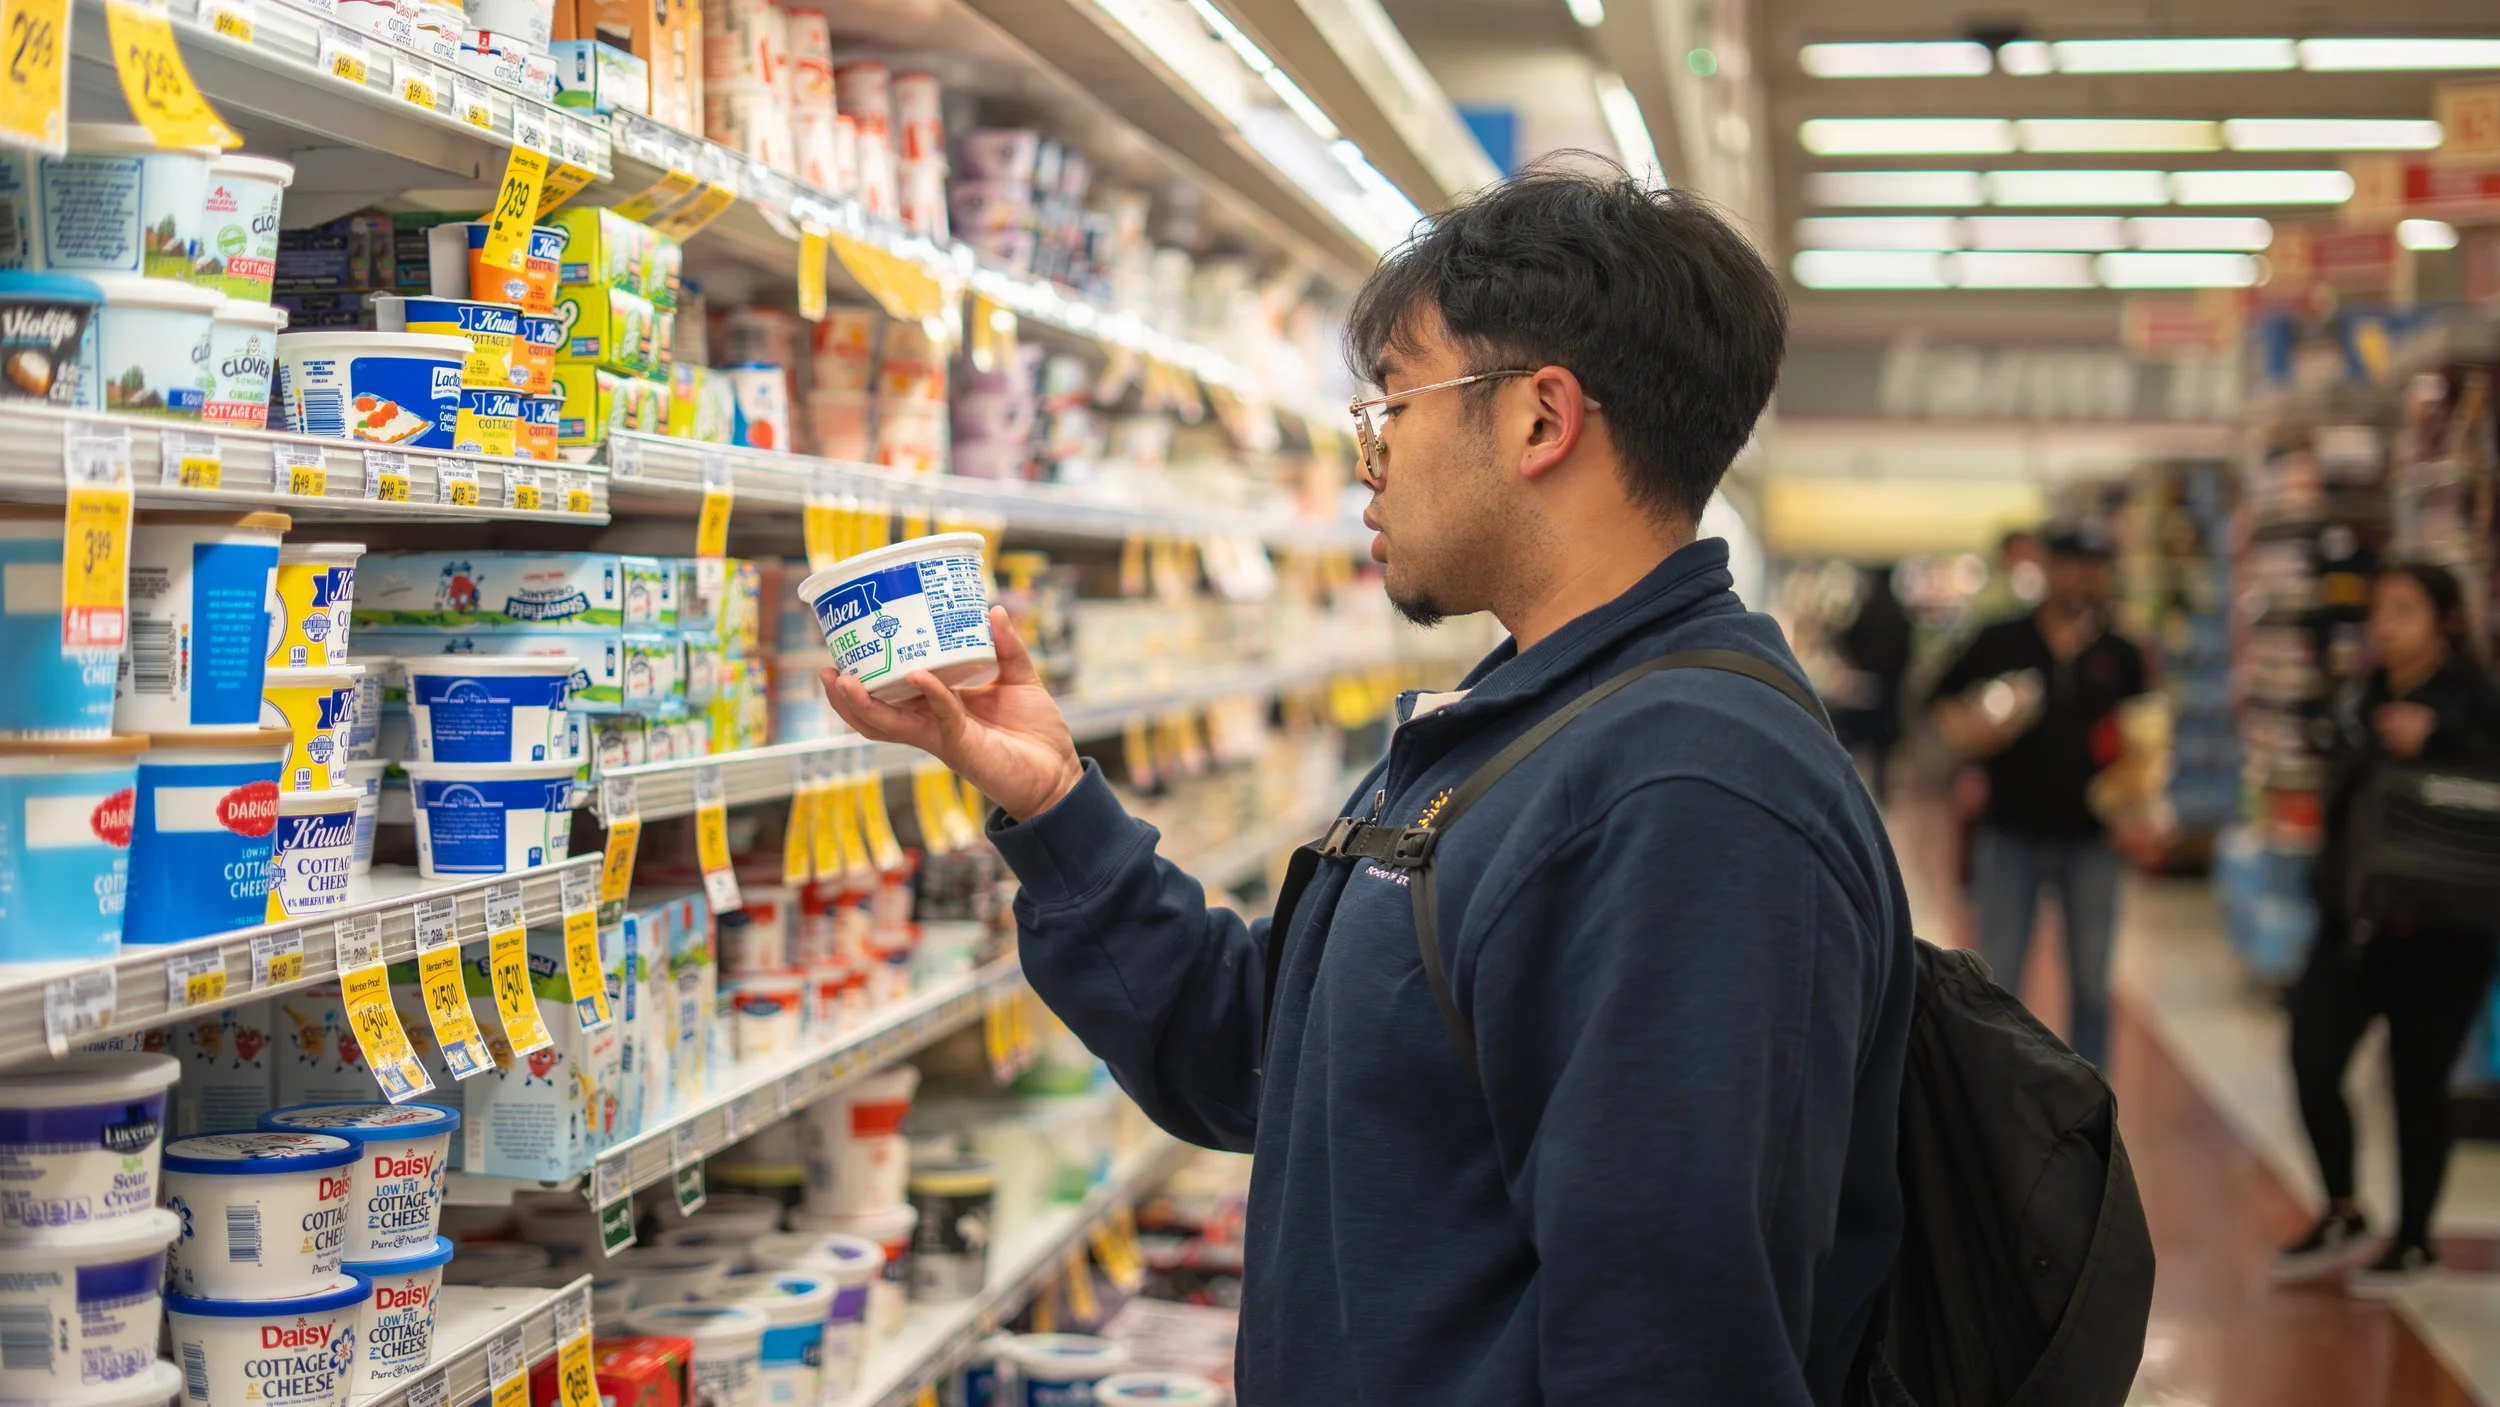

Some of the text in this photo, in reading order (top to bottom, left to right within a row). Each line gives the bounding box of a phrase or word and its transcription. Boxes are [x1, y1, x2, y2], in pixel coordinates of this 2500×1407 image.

[388, 18, 411, 36] COTTAGE
[440, 24, 457, 45] Daisy
[434, 42, 455, 59] COTTAGE
[501, 47, 520, 68] Daisy
[495, 66, 518, 81] COTTAGE
[2, 308, 78, 351] Violife
[222, 356, 270, 382] CLOVER
[294, 473, 310, 495] 649
[380, 480, 394, 500] 649
[919, 560, 944, 570] Nutrition
[922, 568, 936, 576] Facts
[509, 595, 587, 621] Stonyfield
[930, 602, 944, 610] Calories
[303, 620, 331, 628] CALIFORNIA
[834, 629, 860, 654] FREE
[896, 646, 906, 655] NET
[906, 644, 915, 652] WT
[293, 648, 306, 658] 110
[846, 639, 884, 666] CHEESE
[308, 742, 334, 752] CALIFORNIA
[297, 771, 310, 780] 110
[287, 898, 298, 908] 4%
[299, 894, 325, 907] MILKFAT
[496, 940, 510, 950] Member
[426, 958, 454, 972] Member Price!
[350, 979, 380, 993] Member Price!
[375, 1154, 434, 1179] Daisy
[113, 1171, 148, 1191] Sour
[376, 1180, 420, 1197] LOW FAT
[104, 1186, 151, 1209] Cream
[368, 1191, 428, 1213] COTTAGE
[381, 1206, 431, 1228] CHEESE
[371, 1230, 432, 1250] Pure & Natural
[376, 1285, 432, 1310] Daisy
[378, 1310, 418, 1328] LOW FAT
[262, 1324, 333, 1350] Daisy
[369, 1320, 426, 1344] COTTAGE
[381, 1334, 428, 1358] CHEESE
[244, 1352, 328, 1378] COTTAGE
[370, 1370, 392, 1380] Pure
[392, 1364, 406, 1378] &
[262, 1371, 336, 1399] CHEESE
